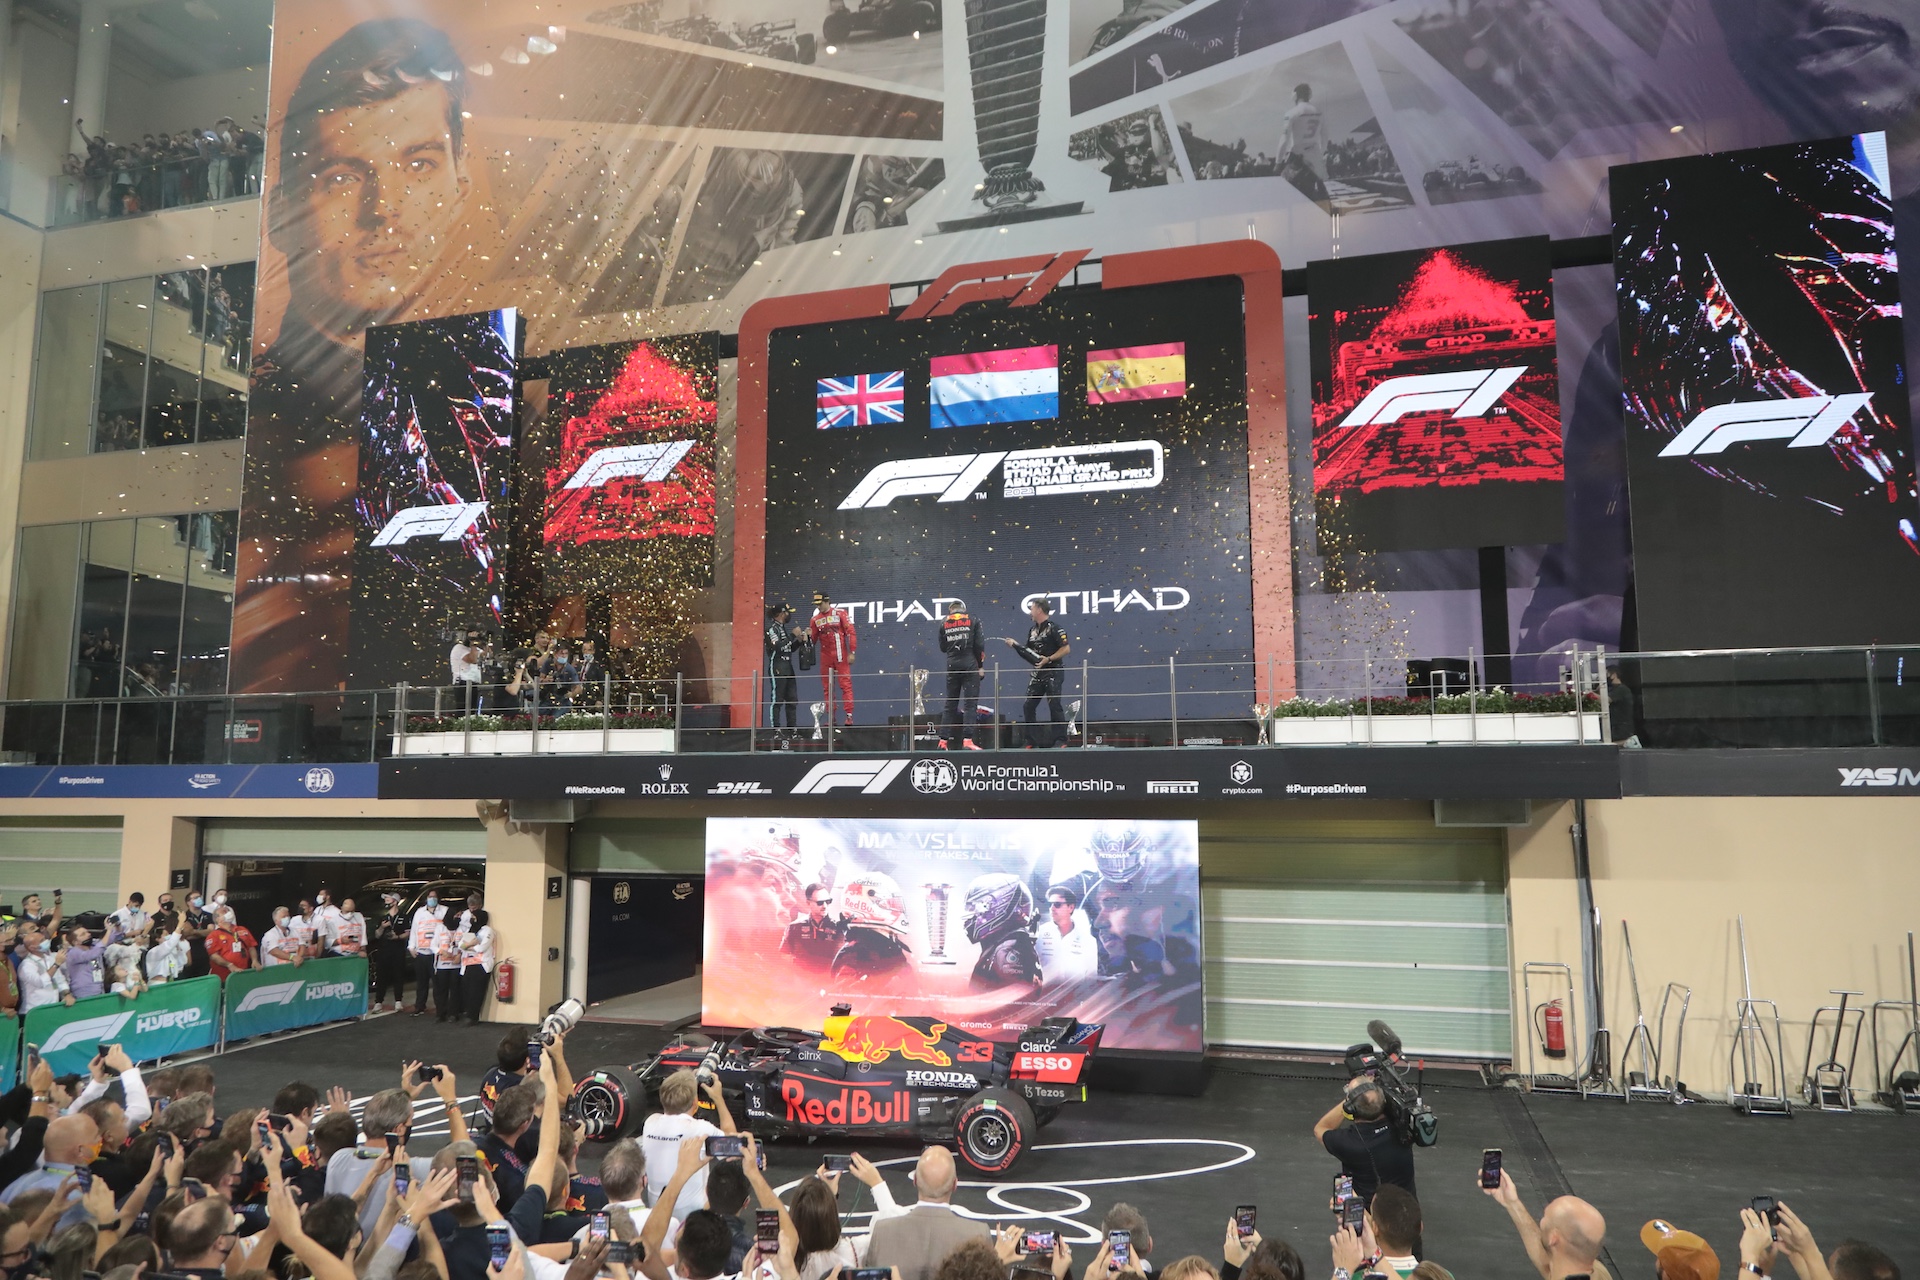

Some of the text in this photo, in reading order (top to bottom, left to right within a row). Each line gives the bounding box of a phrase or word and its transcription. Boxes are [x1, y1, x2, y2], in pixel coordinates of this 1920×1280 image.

[1425, 333, 1486, 348] ETIHAD
[1004, 457, 1068, 470] FORMULA
[1004, 462, 1111, 479] ETIHAD AIRWAYS
[1004, 467, 1153, 488] ABU DHABI GRAND PRIX
[1004, 487, 1035, 497] 2021
[812, 598, 967, 624] TIHAD
[945, 626, 970, 634] HONDA
[781, 740, 790, 750] 2
[961, 765, 1059, 777] FIA Formula 1
[58, 776, 104, 786] #PurposeDriven
[961, 778, 1005, 791] World
[1007, 778, 1114, 793] Championship
[565, 785, 625, 795] #WeRaceAsOne
[641, 783, 690, 795] ROLEX
[716, 782, 764, 795] DHL
[1147, 781, 1199, 794] PIRELLI
[1222, 787, 1263, 795] crypto.com
[1286, 783, 1367, 796] #PurposeDriven
[936, 850, 969, 860] TAKES
[971, 850, 992, 860] ALL
[177, 874, 184, 884] 3
[551, 882, 558, 893] 2
[845, 897, 861, 909] Red
[306, 981, 355, 1000] HYBRID
[136, 1007, 201, 1034] HYBRID
[957, 1041, 993, 1063] 33
[1020, 1041, 1051, 1053] Claro
[798, 1050, 822, 1060] citrix
[1020, 1057, 1072, 1070] ESSO
[906, 1070, 978, 1084] HONDA
[1035, 1086, 1065, 1097] Tezos
[781, 1078, 910, 1125] Red Bull
[748, 1108, 765, 1117] Tezos
[646, 1134, 684, 1142] McLaren
